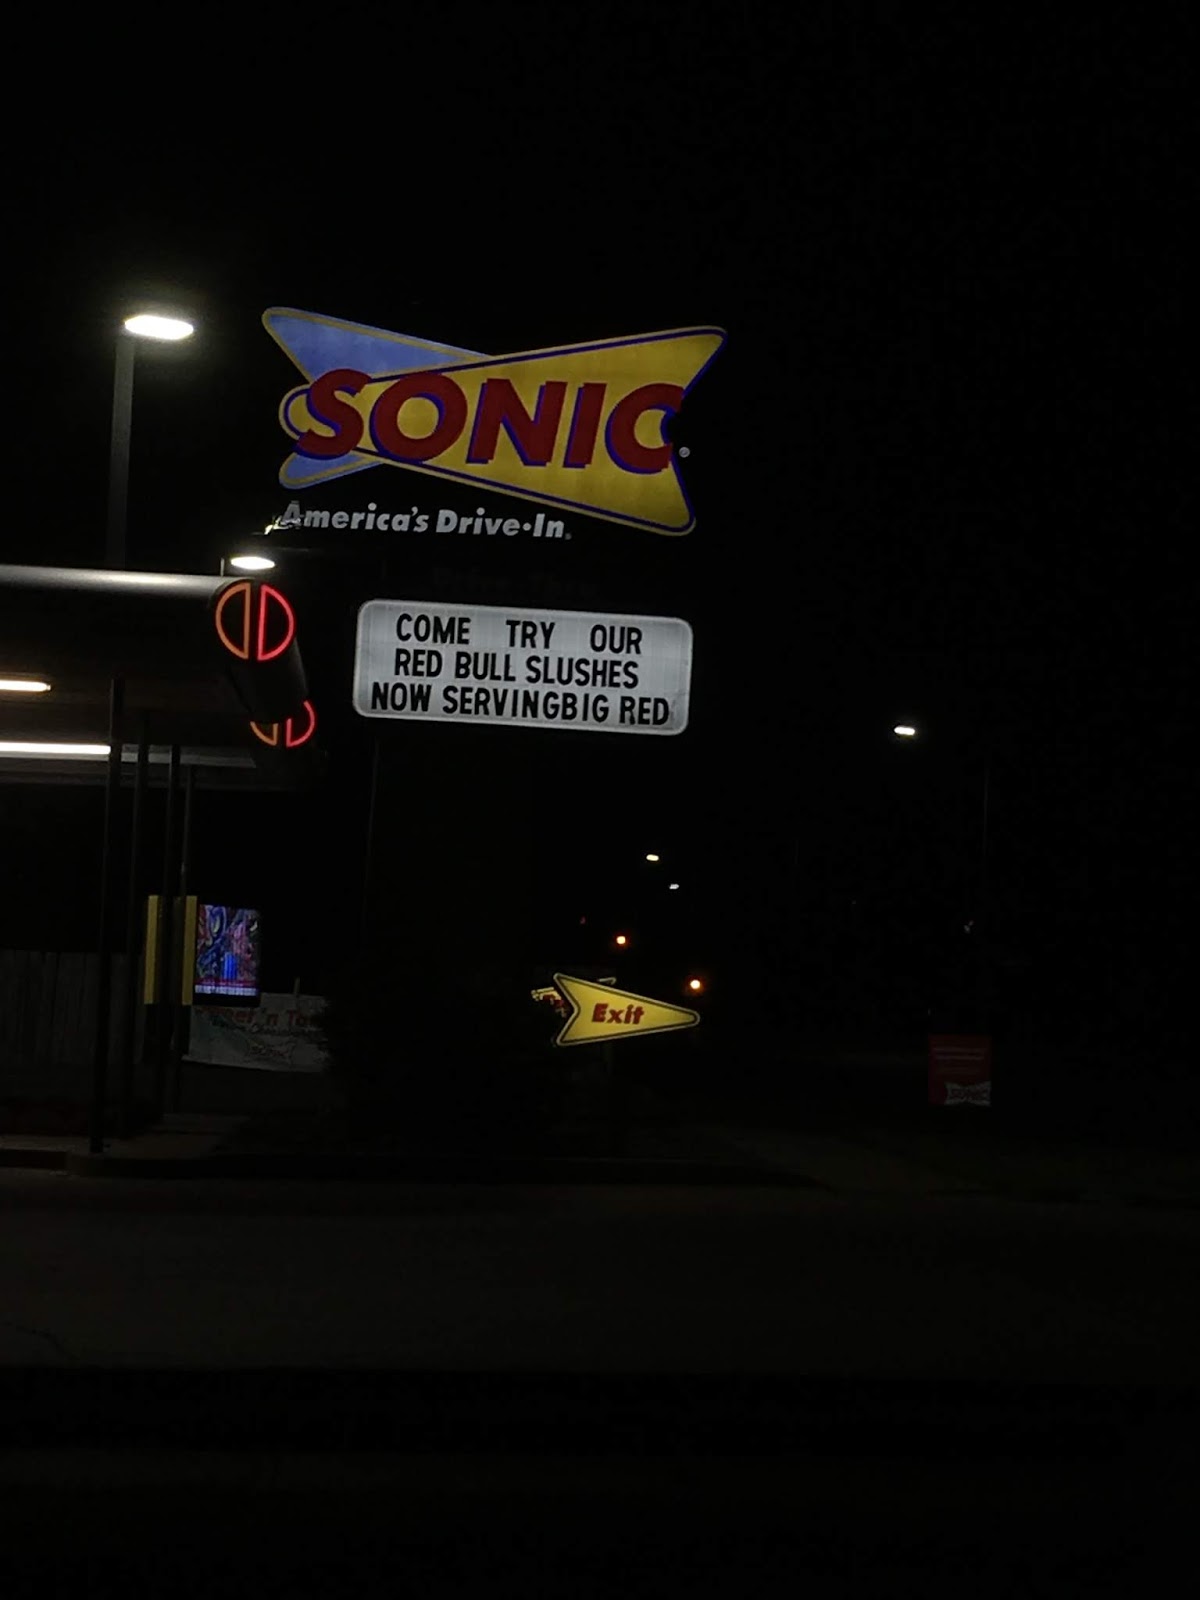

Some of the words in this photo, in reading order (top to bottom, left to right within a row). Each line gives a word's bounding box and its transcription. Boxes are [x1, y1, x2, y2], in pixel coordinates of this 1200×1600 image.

[295, 368, 684, 474] SONIC
[281, 502, 429, 533] America's
[396, 613, 471, 645] COME
[506, 619, 555, 649] TRY
[590, 624, 642, 654] OUR
[394, 648, 443, 677] RED
[455, 652, 515, 682] BULL
[525, 656, 639, 689] SLUSHES
[371, 681, 432, 712] NOW
[619, 696, 669, 725] RED
[592, 1003, 644, 1024] Exit
